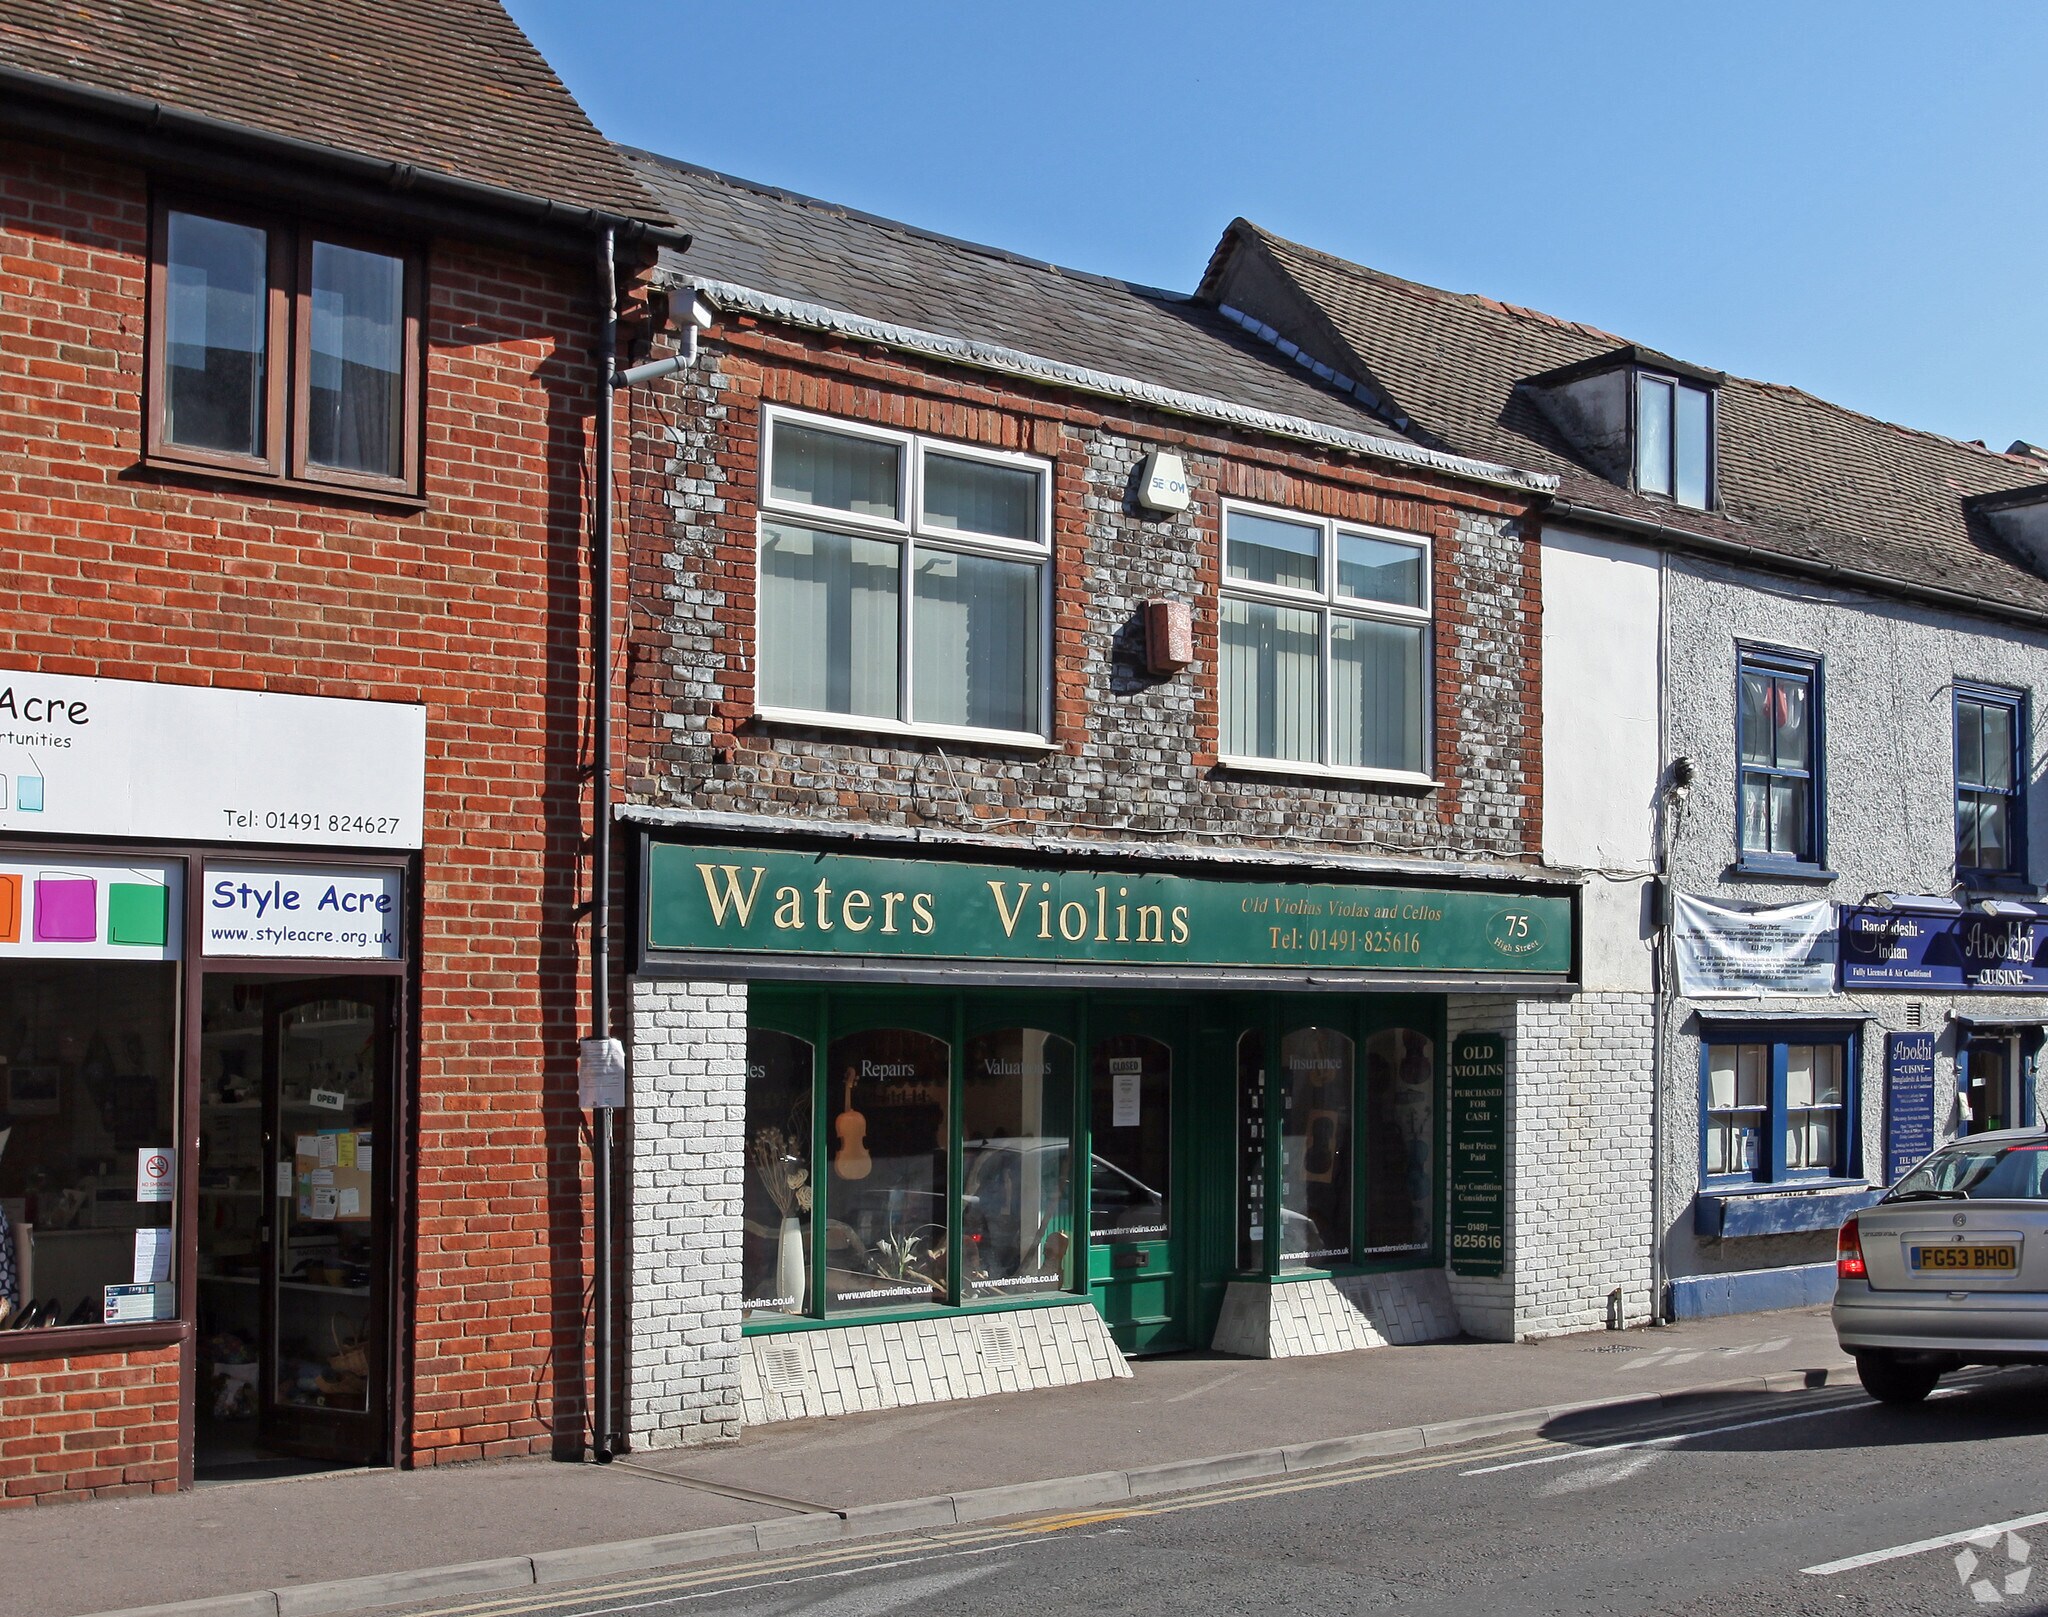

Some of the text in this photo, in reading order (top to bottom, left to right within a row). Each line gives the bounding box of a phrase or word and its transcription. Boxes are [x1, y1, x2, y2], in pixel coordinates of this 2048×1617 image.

[1152, 477, 1185, 494] SEOM
[0, 686, 89, 724] Acre
[223, 809, 401, 835] Tel: 01491 824627
[211, 880, 393, 919] Style Acre
[695, 863, 1190, 945] Waters Violins
[1241, 896, 1442, 921] Old Violins Violas and Cellos
[1505, 915, 1529, 938] 75
[1861, 918, 1918, 940] Bangladeshi
[211, 926, 393, 947] www.styleacre.org.uk
[1269, 926, 1303, 949] Tel:
[1364, 931, 1421, 954] 825616
[1965, 921, 2035, 963] Anokhi
[1493, 937, 1539, 953] High Street
[1878, 943, 1908, 960] Indian
[1852, 967, 1932, 978] Fully Licensed & Air Conditioned
[1980, 969, 2025, 985] CUISINE
[1463, 1045, 1494, 1060] OLD
[1892, 1038, 1932, 1061] Anokhi
[861, 1059, 915, 1081] Repairs
[1112, 1060, 1139, 1072] CLOSED
[1289, 1055, 1342, 1070] Insurance
[1454, 1063, 1504, 1077] VIOLINS
[1900, 1064, 1925, 1074] CUISINE
[316, 1093, 338, 1105] OPEN
[1454, 1088, 1503, 1098] PURCHASED
[1470, 1100, 1487, 1109] FOR
[1465, 1111, 1490, 1121] CASH
[1459, 1142, 1497, 1150] Best Prices
[1470, 1153, 1486, 1161] Paid
[1454, 1183, 1502, 1192] Any Condition
[1458, 1193, 1497, 1202] Considered
[1467, 1223, 1488, 1231] 01491
[1453, 1234, 1502, 1249] 825616
[1922, 1250, 1969, 1267] FG53
[971, 1272, 1060, 1289] www.watersviolins.co.uk
[837, 1284, 934, 1302] www.watersviolins.co.uk
